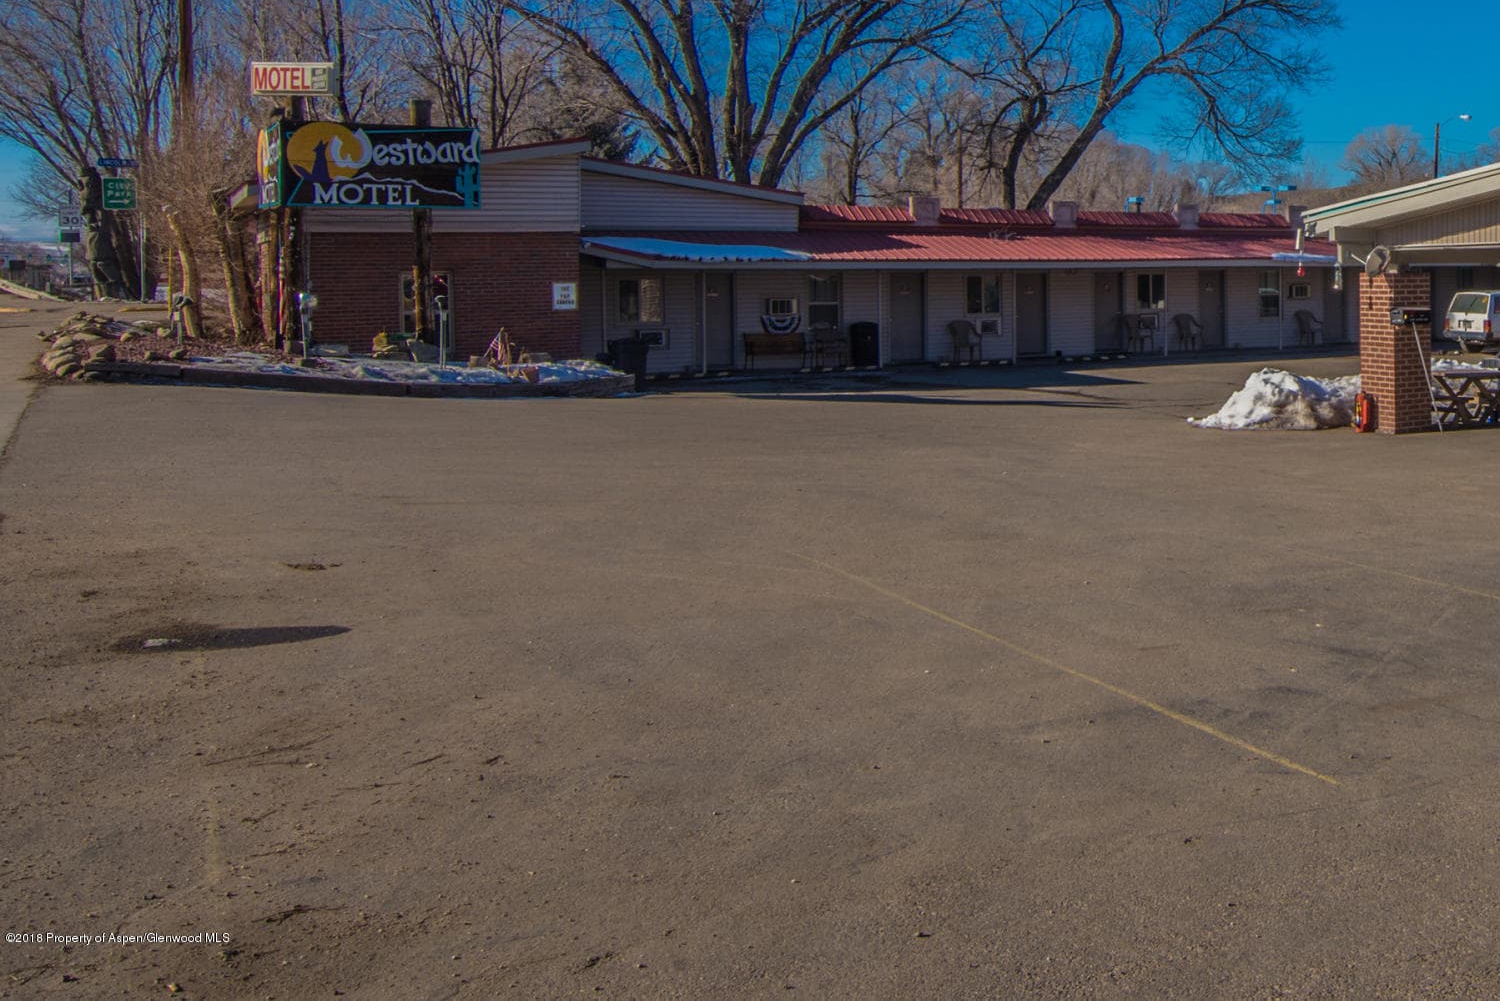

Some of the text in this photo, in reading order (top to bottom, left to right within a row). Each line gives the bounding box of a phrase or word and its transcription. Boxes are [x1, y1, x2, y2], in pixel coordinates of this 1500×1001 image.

[254, 67, 310, 90] MOTEL
[329, 128, 480, 169] Westward
[312, 182, 420, 205] MOTEL
[62, 216, 80, 225] 30
